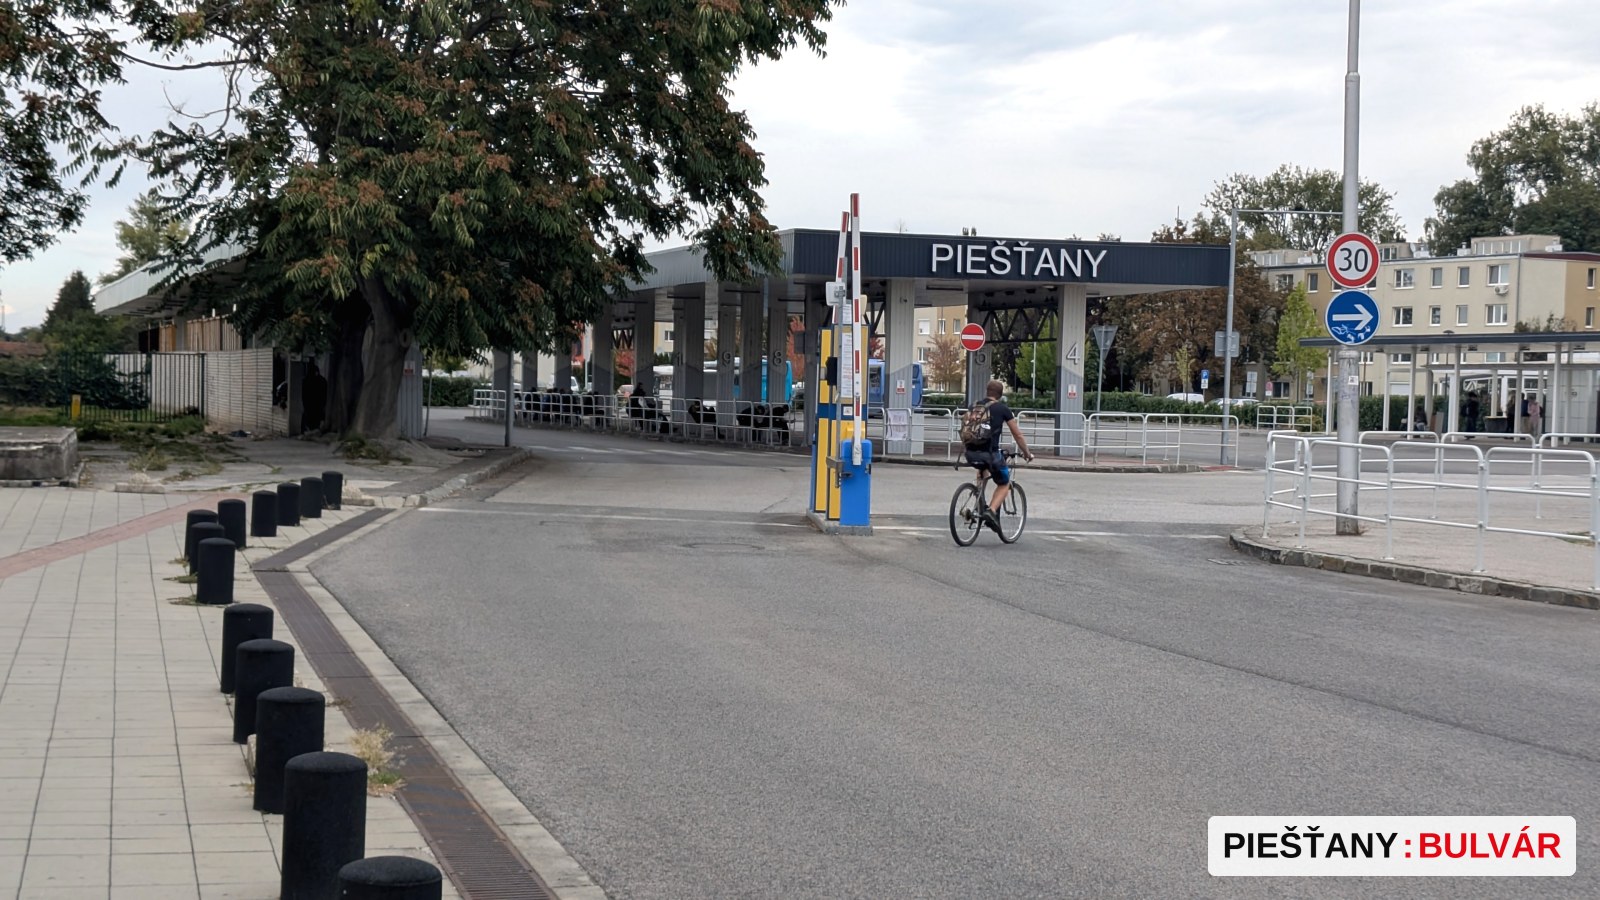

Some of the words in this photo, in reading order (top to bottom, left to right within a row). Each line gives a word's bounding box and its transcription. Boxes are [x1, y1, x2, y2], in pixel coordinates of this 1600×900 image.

[931, 240, 1108, 278] PIEŠŤANY
[1339, 247, 1368, 272] 30
[722, 351, 732, 368] 9
[773, 350, 783, 367] 8
[1066, 342, 1080, 366] 4
